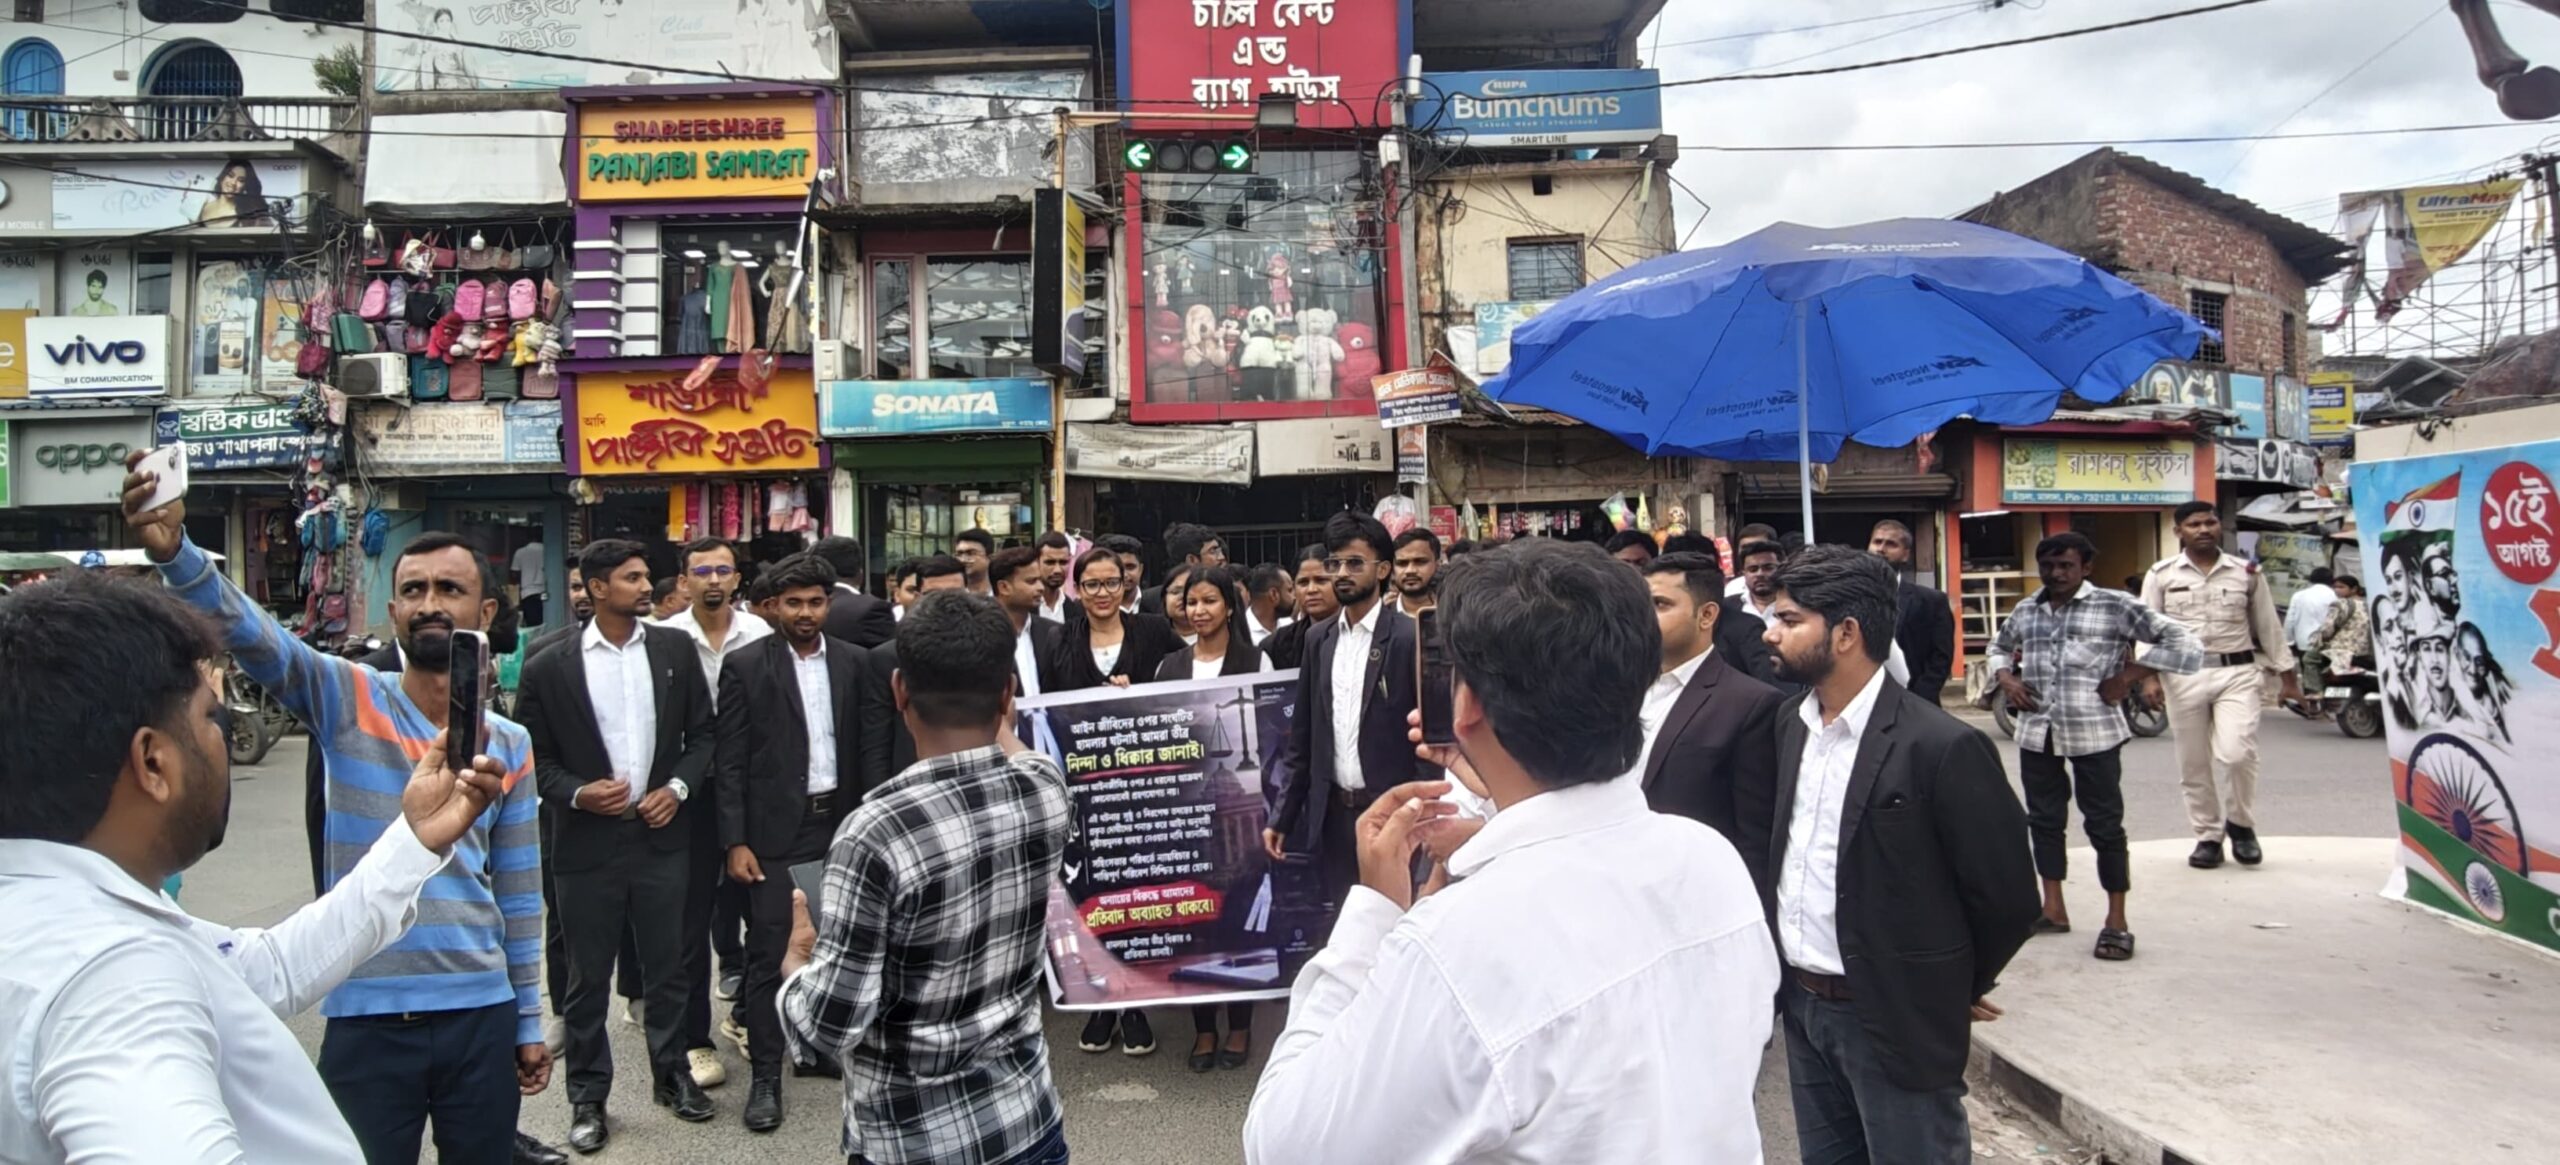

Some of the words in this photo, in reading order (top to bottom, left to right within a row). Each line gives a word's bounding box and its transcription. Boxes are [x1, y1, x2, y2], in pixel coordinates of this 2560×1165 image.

[1191, 78, 1252, 110] ব্যাগ
[1493, 80, 1527, 89] RUPA
[1454, 94, 1621, 119] Bumchums
[613, 118, 785, 143] SHAREESHREE
[1510, 135, 1543, 145] SMART
[1546, 134, 1568, 143] LINE
[588, 152, 697, 185] PANJABI
[705, 149, 810, 180] SAMRAT
[44, 334, 145, 365] vivo
[80, 375, 153, 384] COMMUNICATION
[872, 391, 999, 417] SONATA
[181, 409, 249, 432] স্বস্তিক
[251, 408, 294, 429] ভাণ্ড
[584, 413, 606, 428] আদি
[36, 443, 129, 474] oppo
[205, 442, 214, 456] ও
[2484, 471, 2554, 536] ১৫ই
[1070, 721, 1095, 735] আইন
[1137, 715, 1158, 727] ওপর
[1141, 730, 1168, 743] আমরা
[1066, 753, 1098, 773] নিন্দা
[1101, 754, 1112, 768] ও
[1115, 747, 1155, 767] ধিক্কার
[1086, 907, 1125, 928] প্রতিবাদ
[1128, 903, 1173, 920] অব্যাহত
